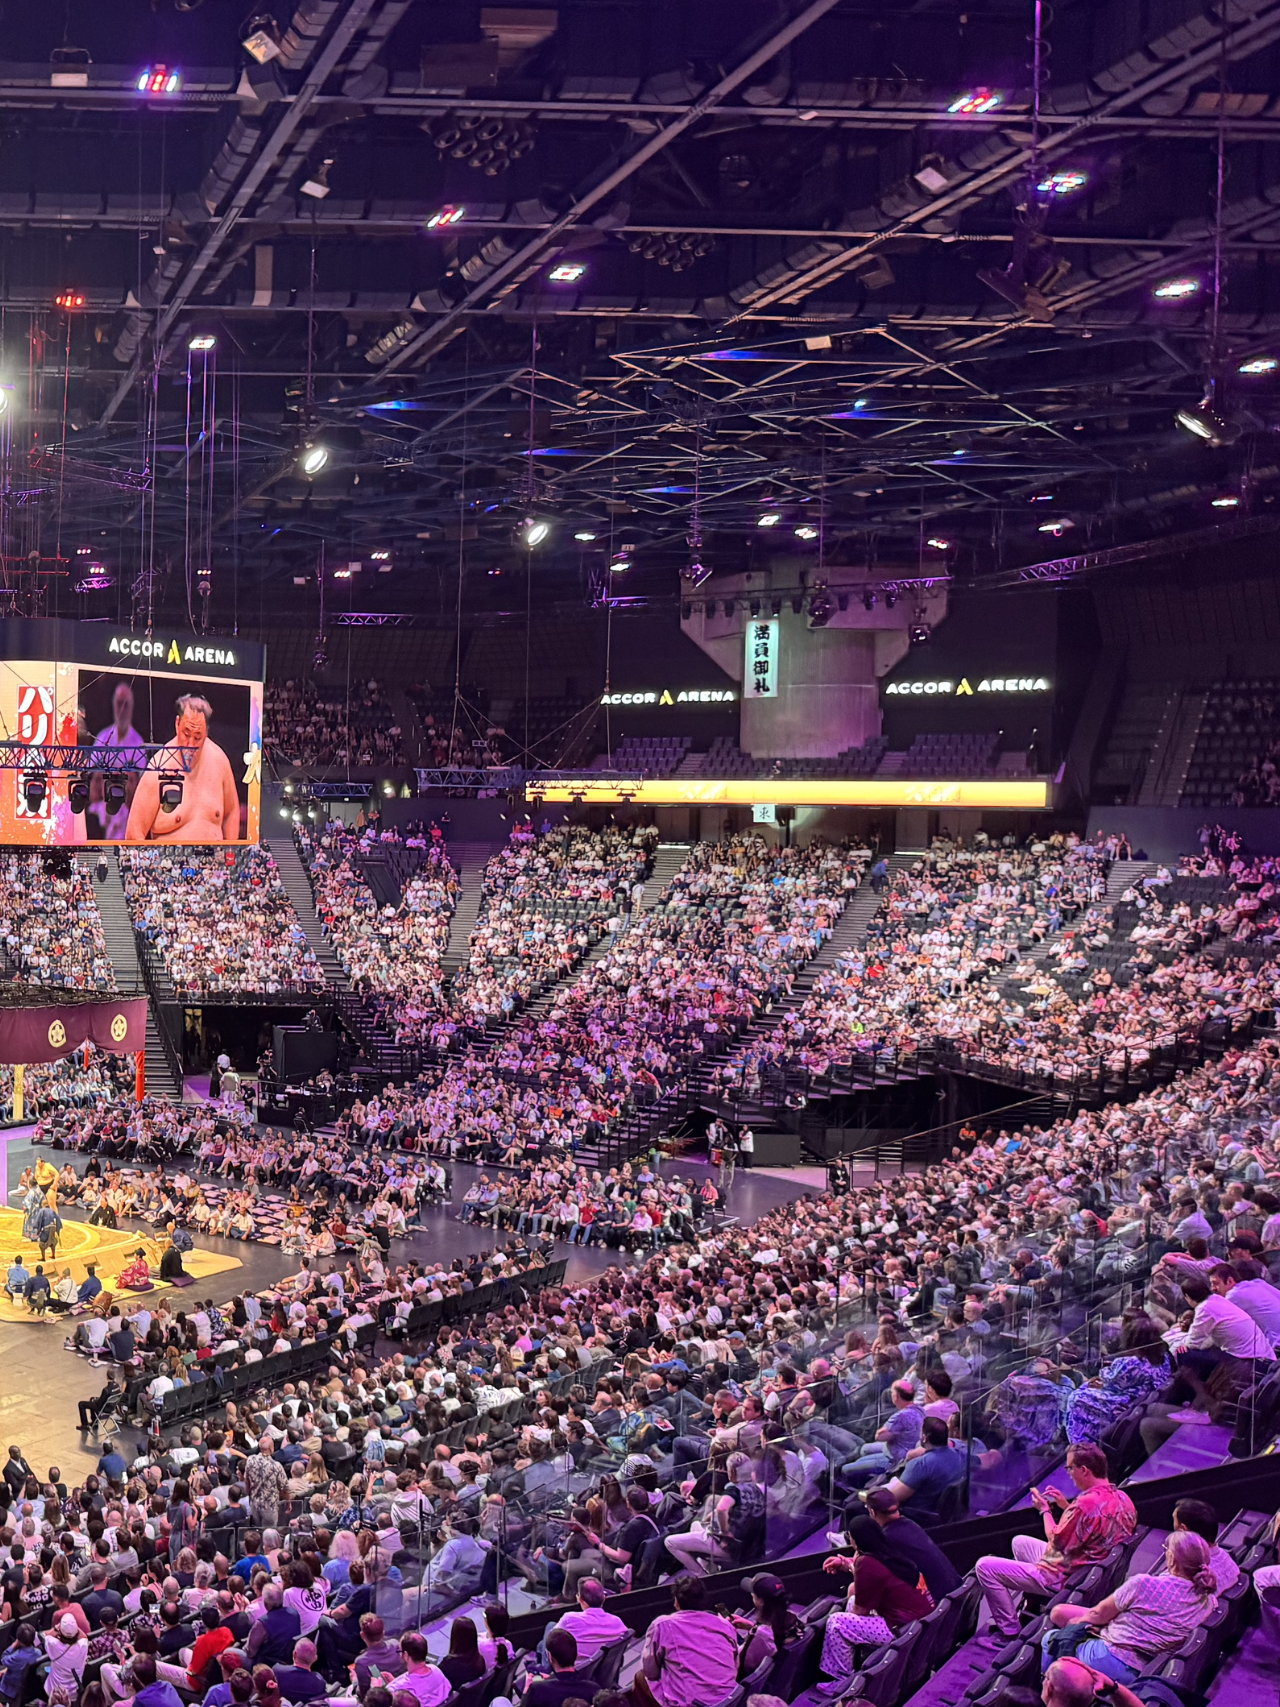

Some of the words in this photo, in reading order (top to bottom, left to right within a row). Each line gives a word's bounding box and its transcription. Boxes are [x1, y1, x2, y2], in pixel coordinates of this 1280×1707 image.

[108, 636, 163, 657] ACCOR
[184, 645, 236, 666] ARENA
[885, 681, 951, 695] ACCOR
[976, 678, 1049, 691] ARENA
[600, 692, 656, 705] ACCOR
[676, 690, 735, 703] ARENA
